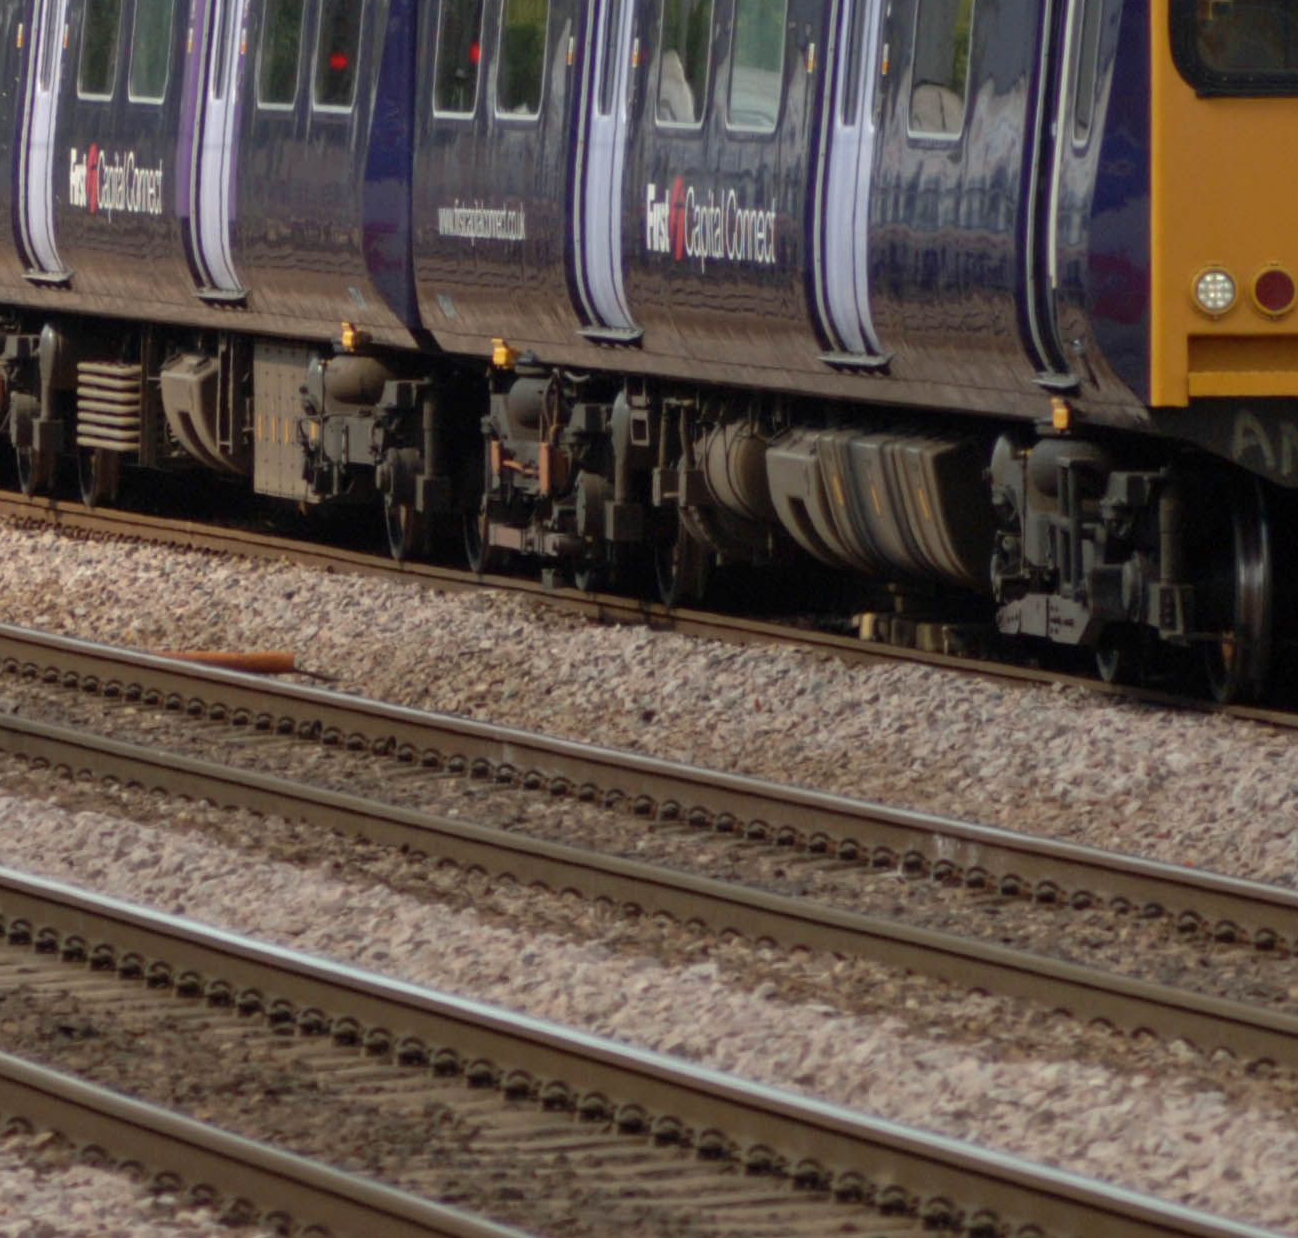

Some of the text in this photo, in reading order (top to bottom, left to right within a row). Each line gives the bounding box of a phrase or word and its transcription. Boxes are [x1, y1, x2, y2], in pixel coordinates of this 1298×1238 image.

[70, 148, 162, 223] First Capital Connect
[647, 183, 776, 274] First Capital Connect
